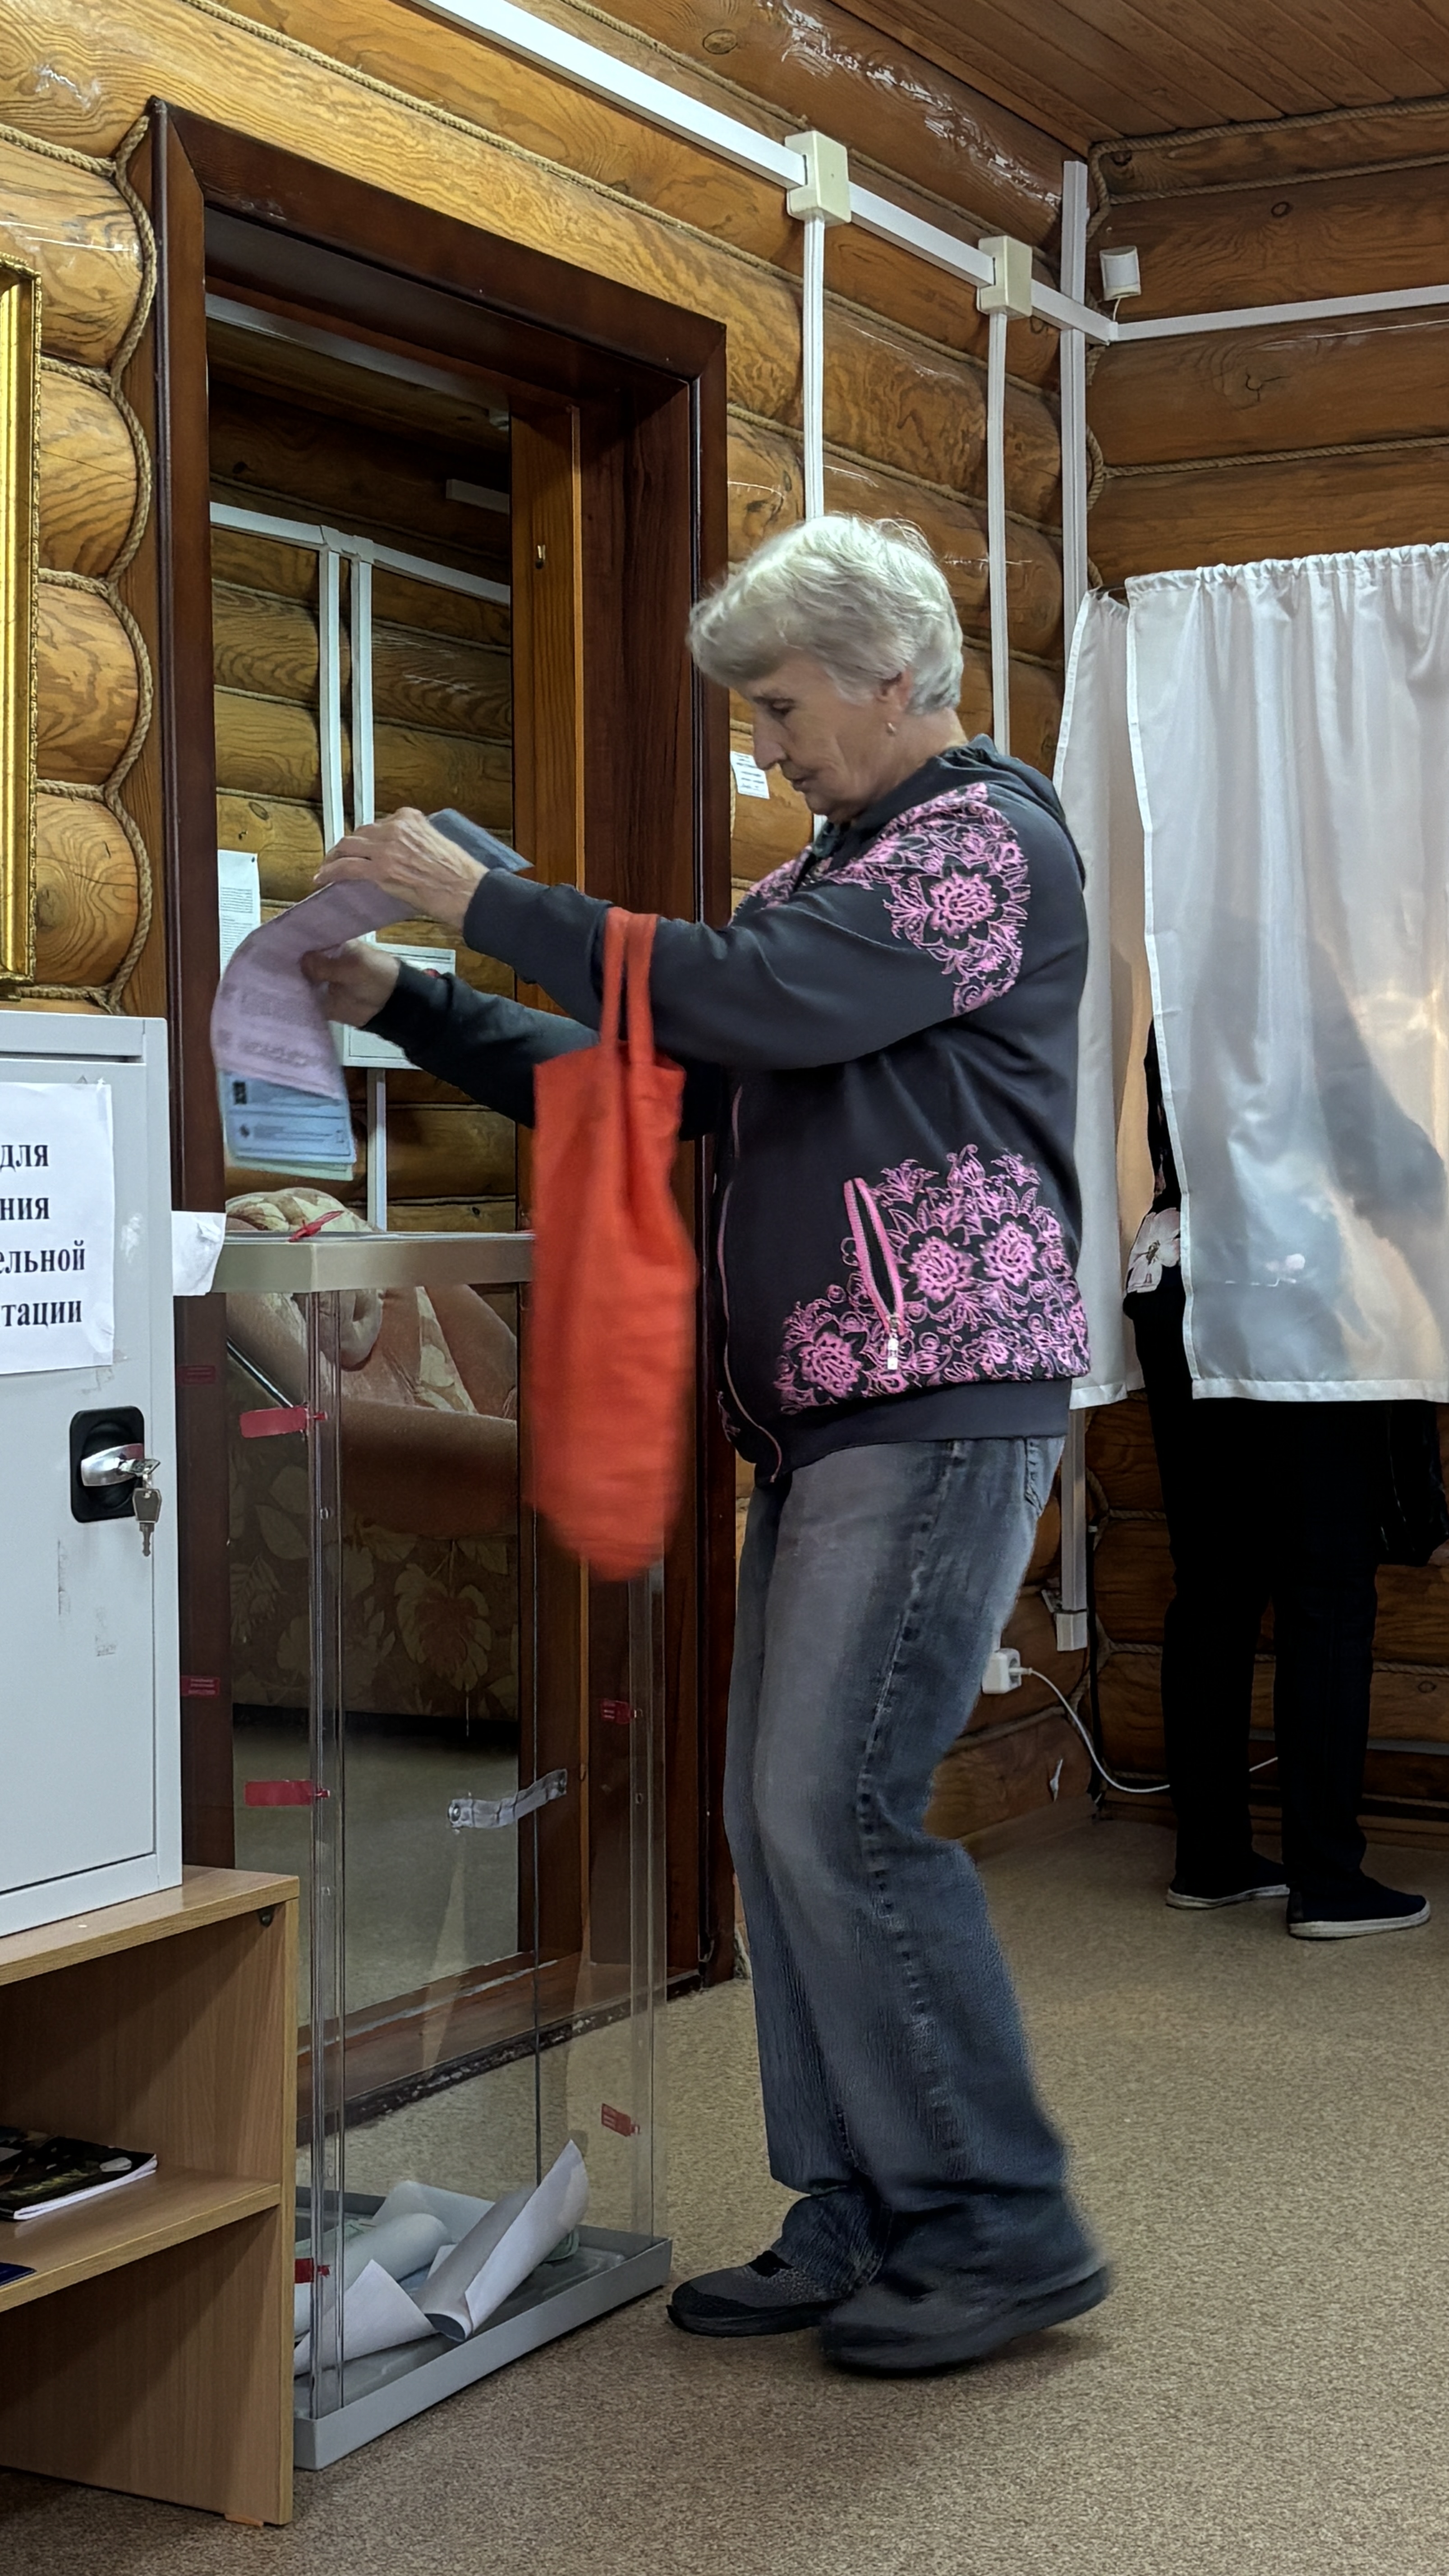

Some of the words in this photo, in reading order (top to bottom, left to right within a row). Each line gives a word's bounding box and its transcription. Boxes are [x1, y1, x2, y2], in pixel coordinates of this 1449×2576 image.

[0, 1145, 49, 1172] для
[0, 1197, 50, 1220] ния
[1, 1300, 82, 1328] тации
